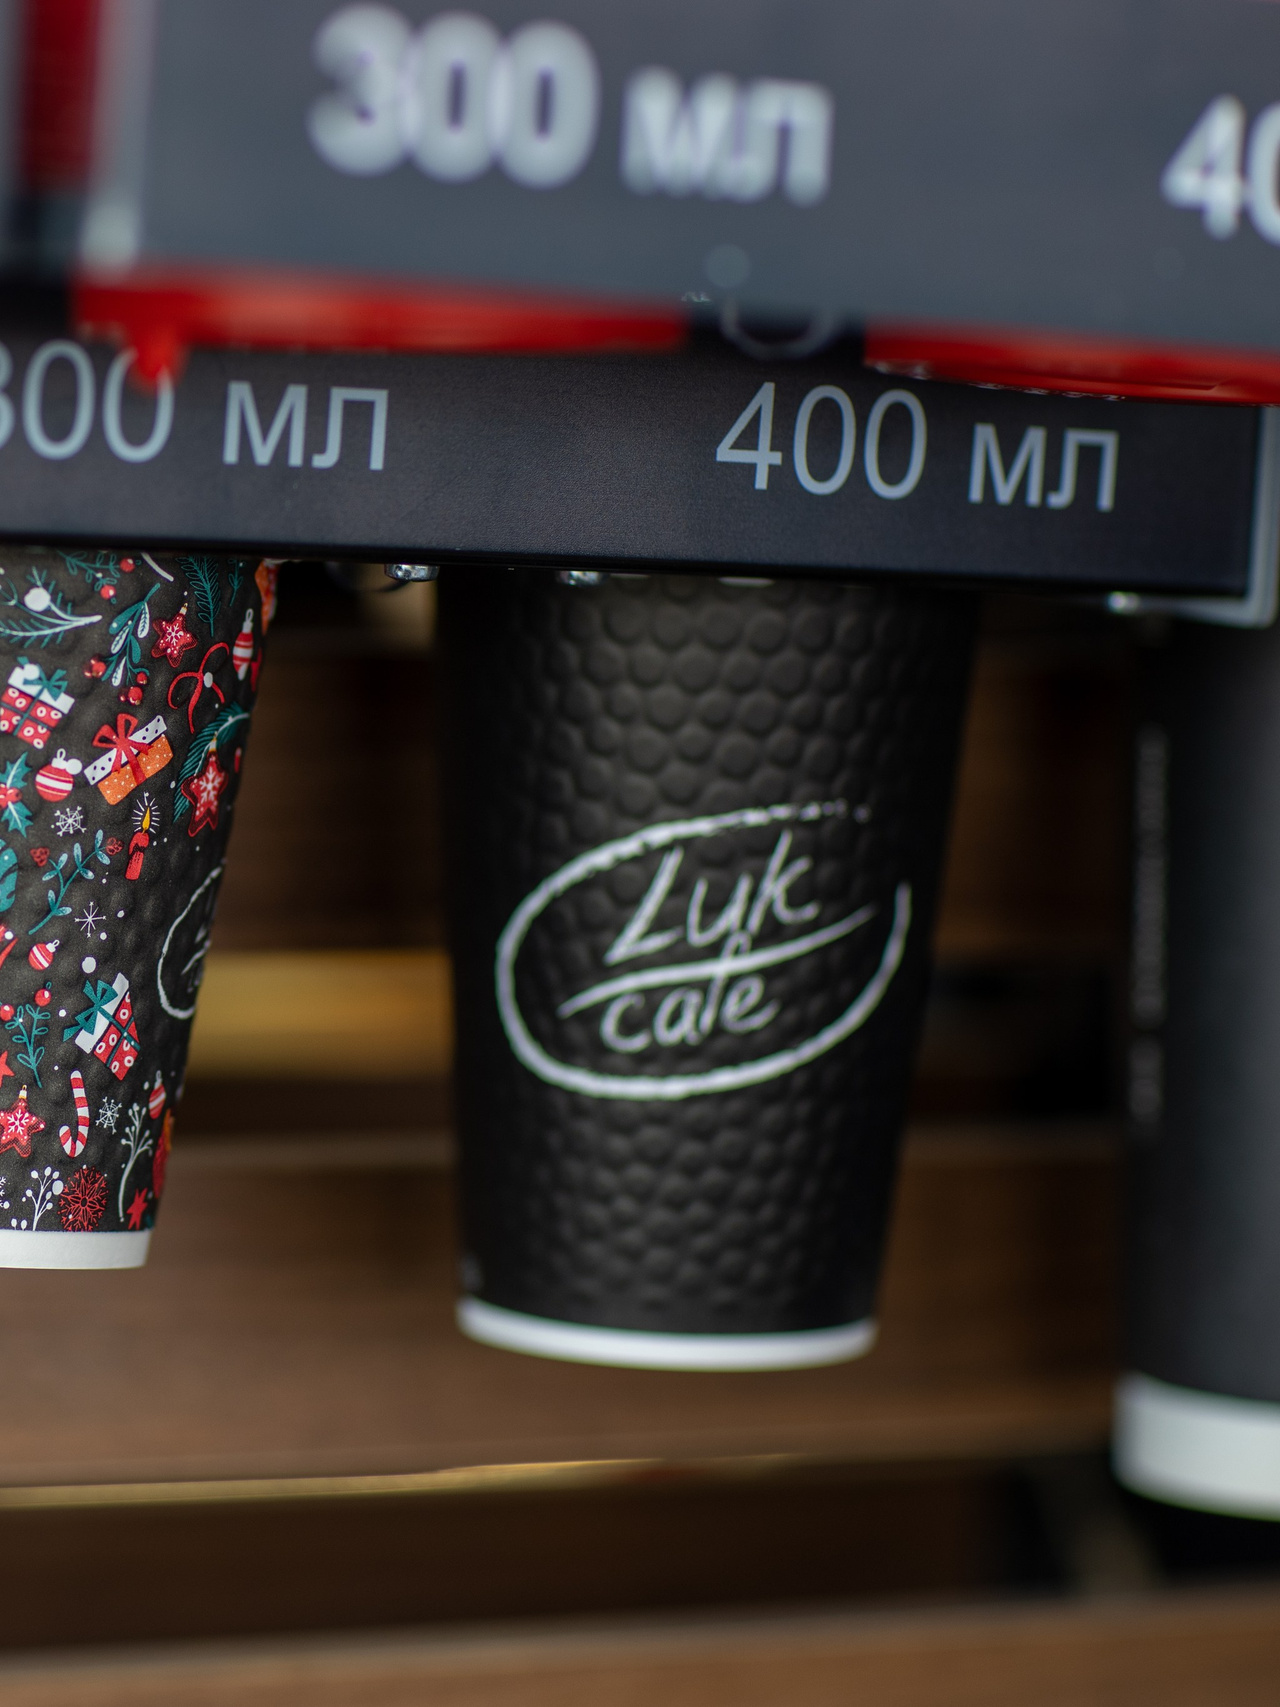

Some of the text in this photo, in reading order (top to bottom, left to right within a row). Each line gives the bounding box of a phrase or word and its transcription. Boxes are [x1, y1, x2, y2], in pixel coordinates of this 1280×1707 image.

[308, 5, 833, 202] 300 мл
[223, 380, 388, 470] мл
[715, 382, 1119, 512] 400 мл
[604, 830, 819, 965] Luk
[600, 931, 779, 1052] cafe
